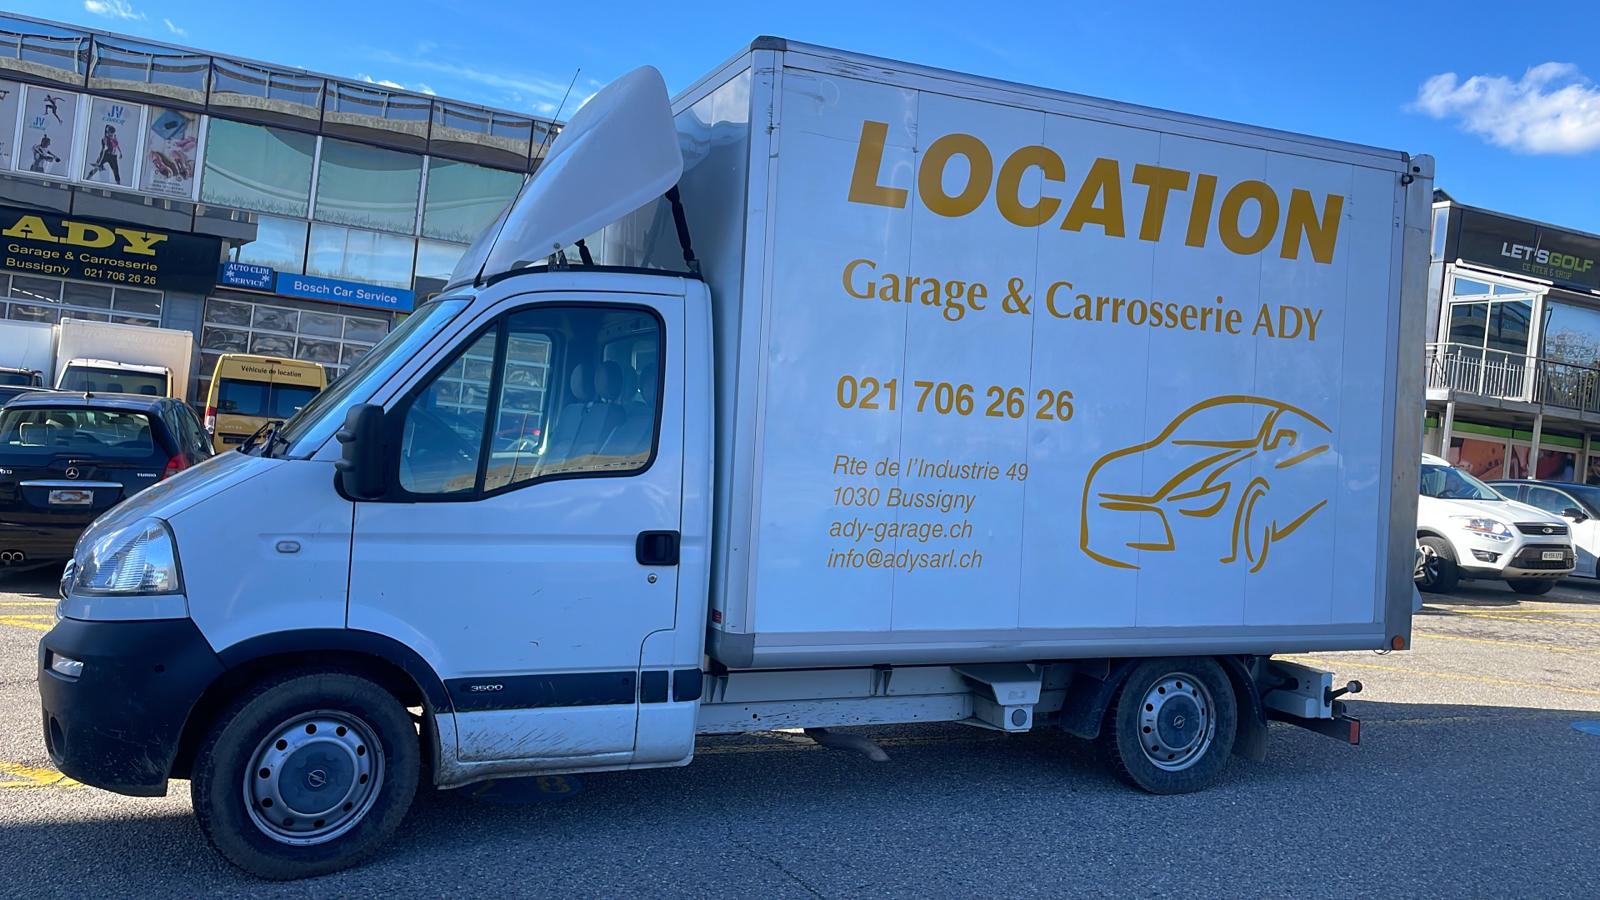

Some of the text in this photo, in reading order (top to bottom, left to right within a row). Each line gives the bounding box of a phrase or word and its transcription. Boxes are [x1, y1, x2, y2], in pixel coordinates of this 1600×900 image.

[848, 120, 1344, 264] LOCATION
[2, 215, 168, 256] ADY
[7, 244, 158, 272] Garage & Carrosserie
[229, 263, 270, 275] AUTO CLIM
[6, 258, 157, 285] Bussigny 021 706 26 26
[230, 277, 265, 287] SERVICE
[294, 281, 398, 304] Bosch Car Service
[843, 259, 1323, 341] Garage & Carrosserie ADY
[277, 368, 302, 378] location
[837, 375, 1074, 421] 021 706 26 26
[833, 455, 1028, 481] Rte de l'Industrie 49
[834, 486, 976, 513] 1030 Bussigny
[829, 517, 973, 543] ady-garage.ch
[826, 548, 983, 573] info@adysarl.ch
[471, 684, 503, 692] 3500
